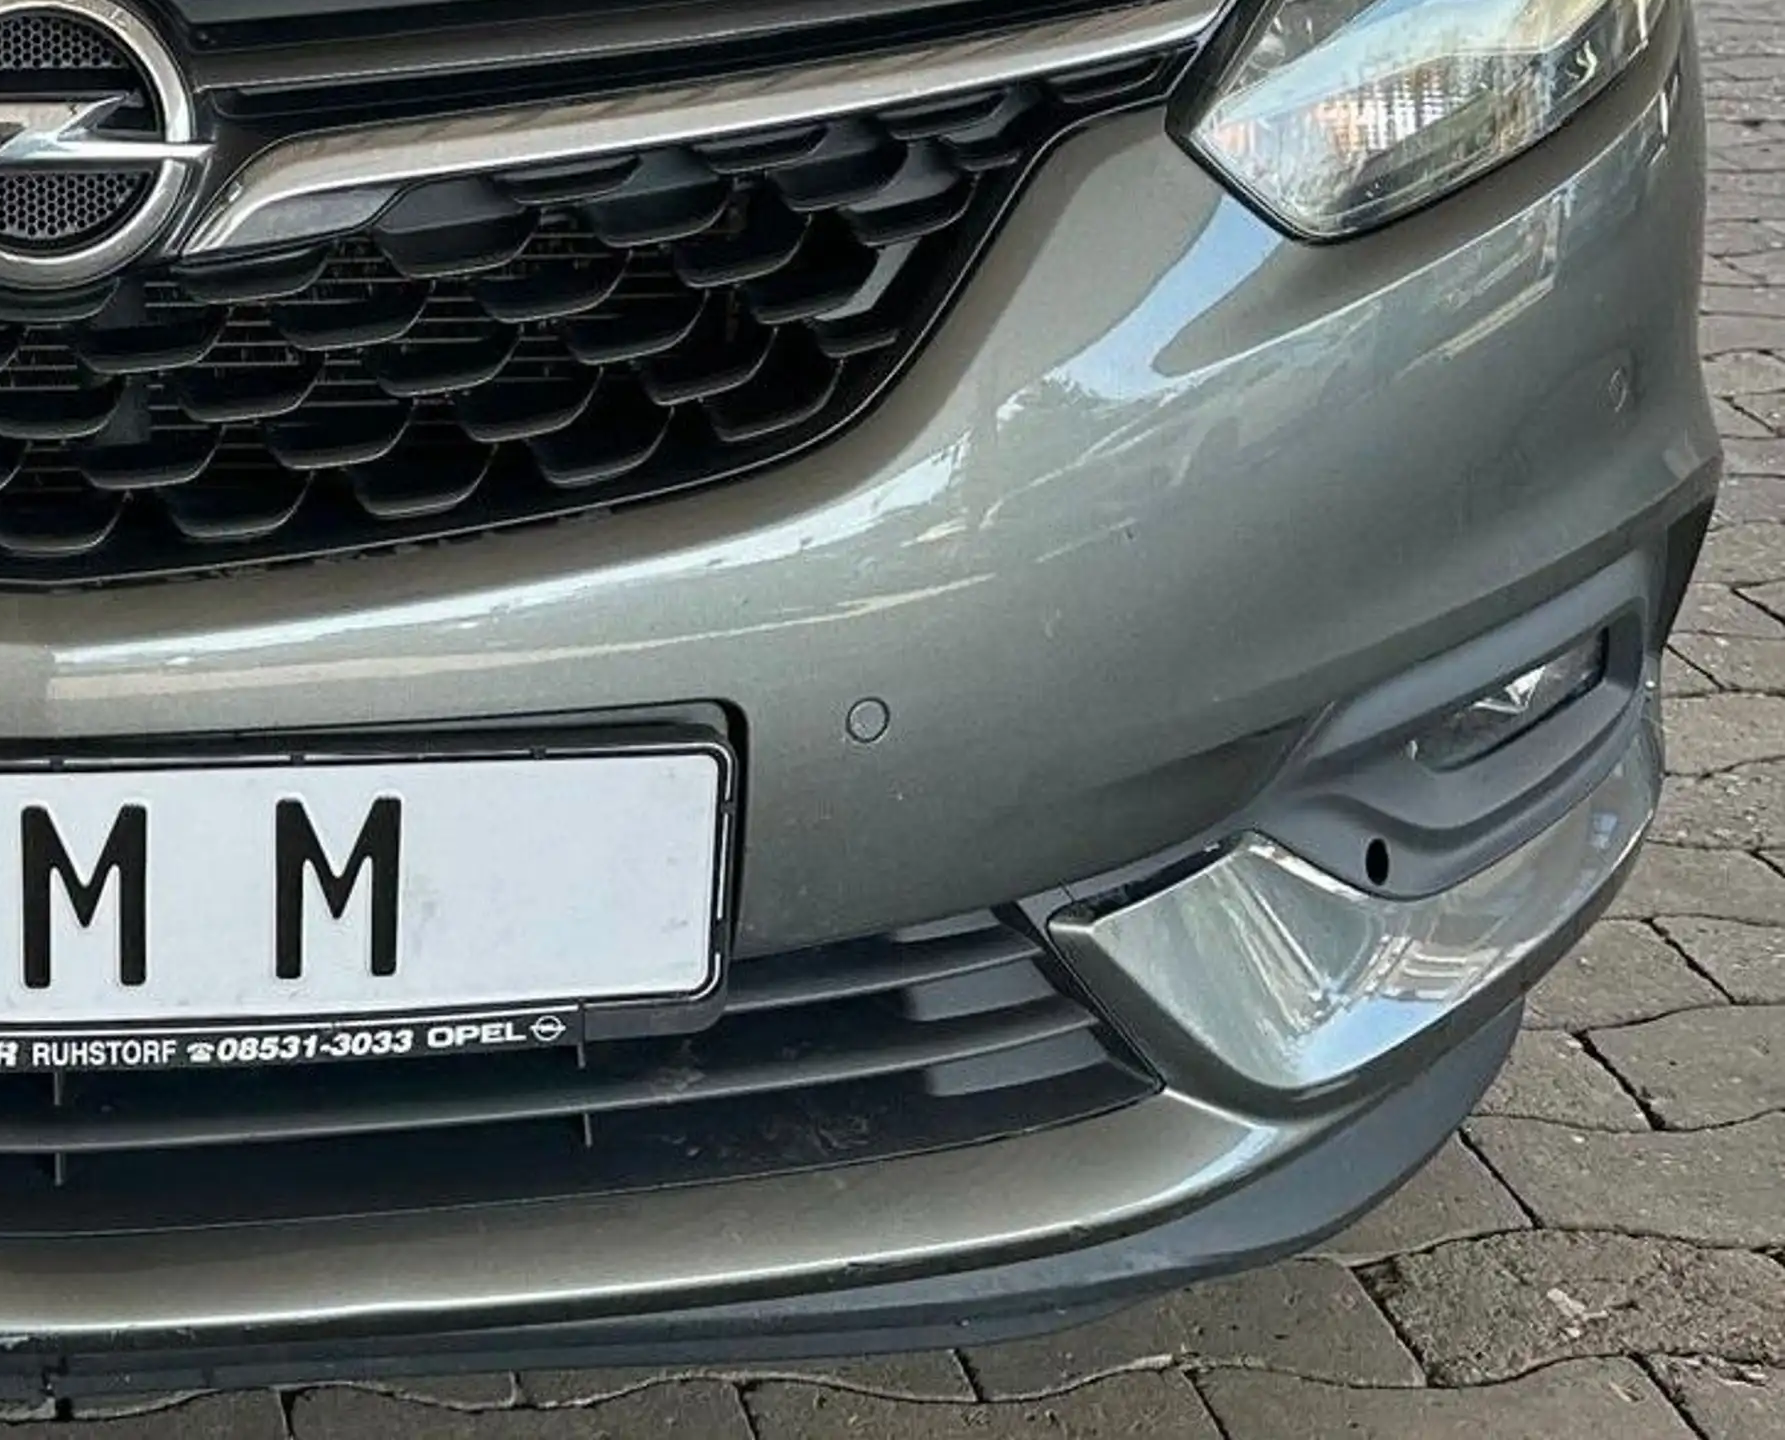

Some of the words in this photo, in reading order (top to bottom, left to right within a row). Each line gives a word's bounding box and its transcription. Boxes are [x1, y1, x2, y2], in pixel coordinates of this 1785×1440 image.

[20, 804, 147, 989] M
[275, 797, 402, 980] M
[32, 1039, 177, 1067] RUHSTORF
[216, 1033, 414, 1063] 08531-3033
[427, 1021, 527, 1048] OPEL
